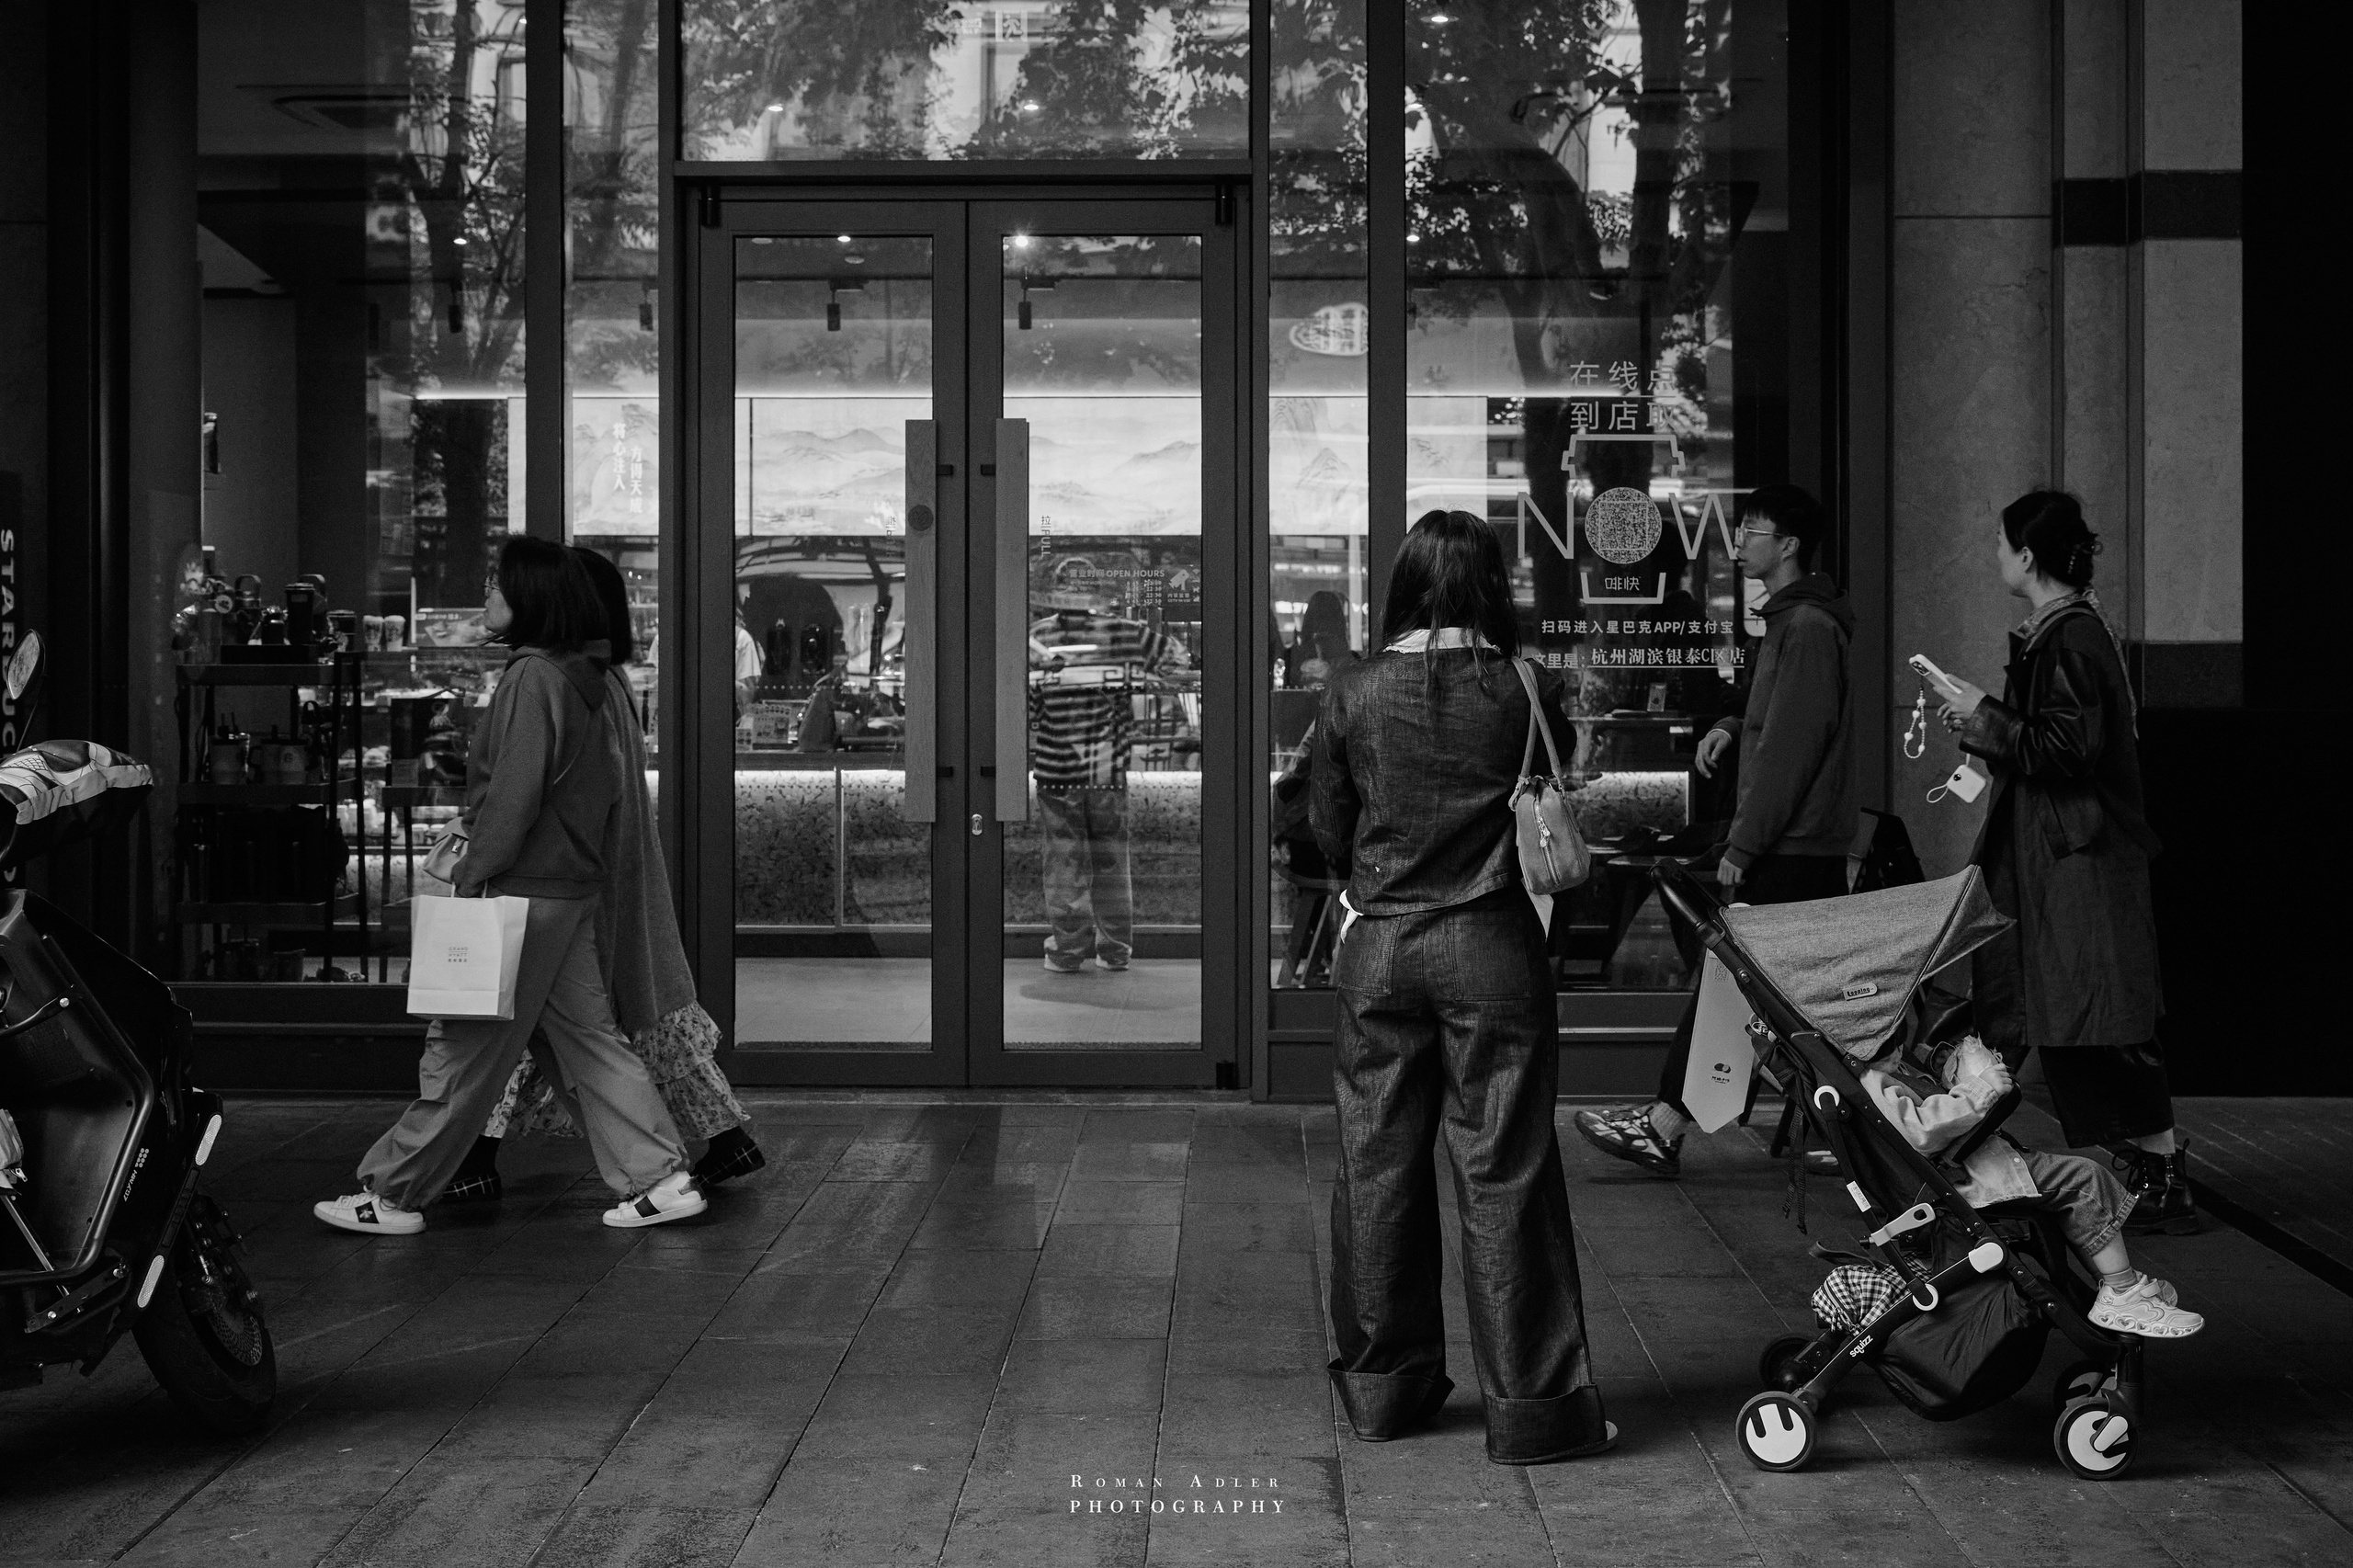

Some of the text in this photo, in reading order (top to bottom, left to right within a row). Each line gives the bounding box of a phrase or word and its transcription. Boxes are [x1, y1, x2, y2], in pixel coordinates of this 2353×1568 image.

[1570, 360, 1676, 392] 在线点
[1570, 401, 1676, 431] 到店取
[1107, 569, 1131, 578] OPEN
[1132, 569, 1165, 578] HOURS
[1605, 576, 1641, 591] 啡快
[1849, 1335, 1874, 1358] squizz
